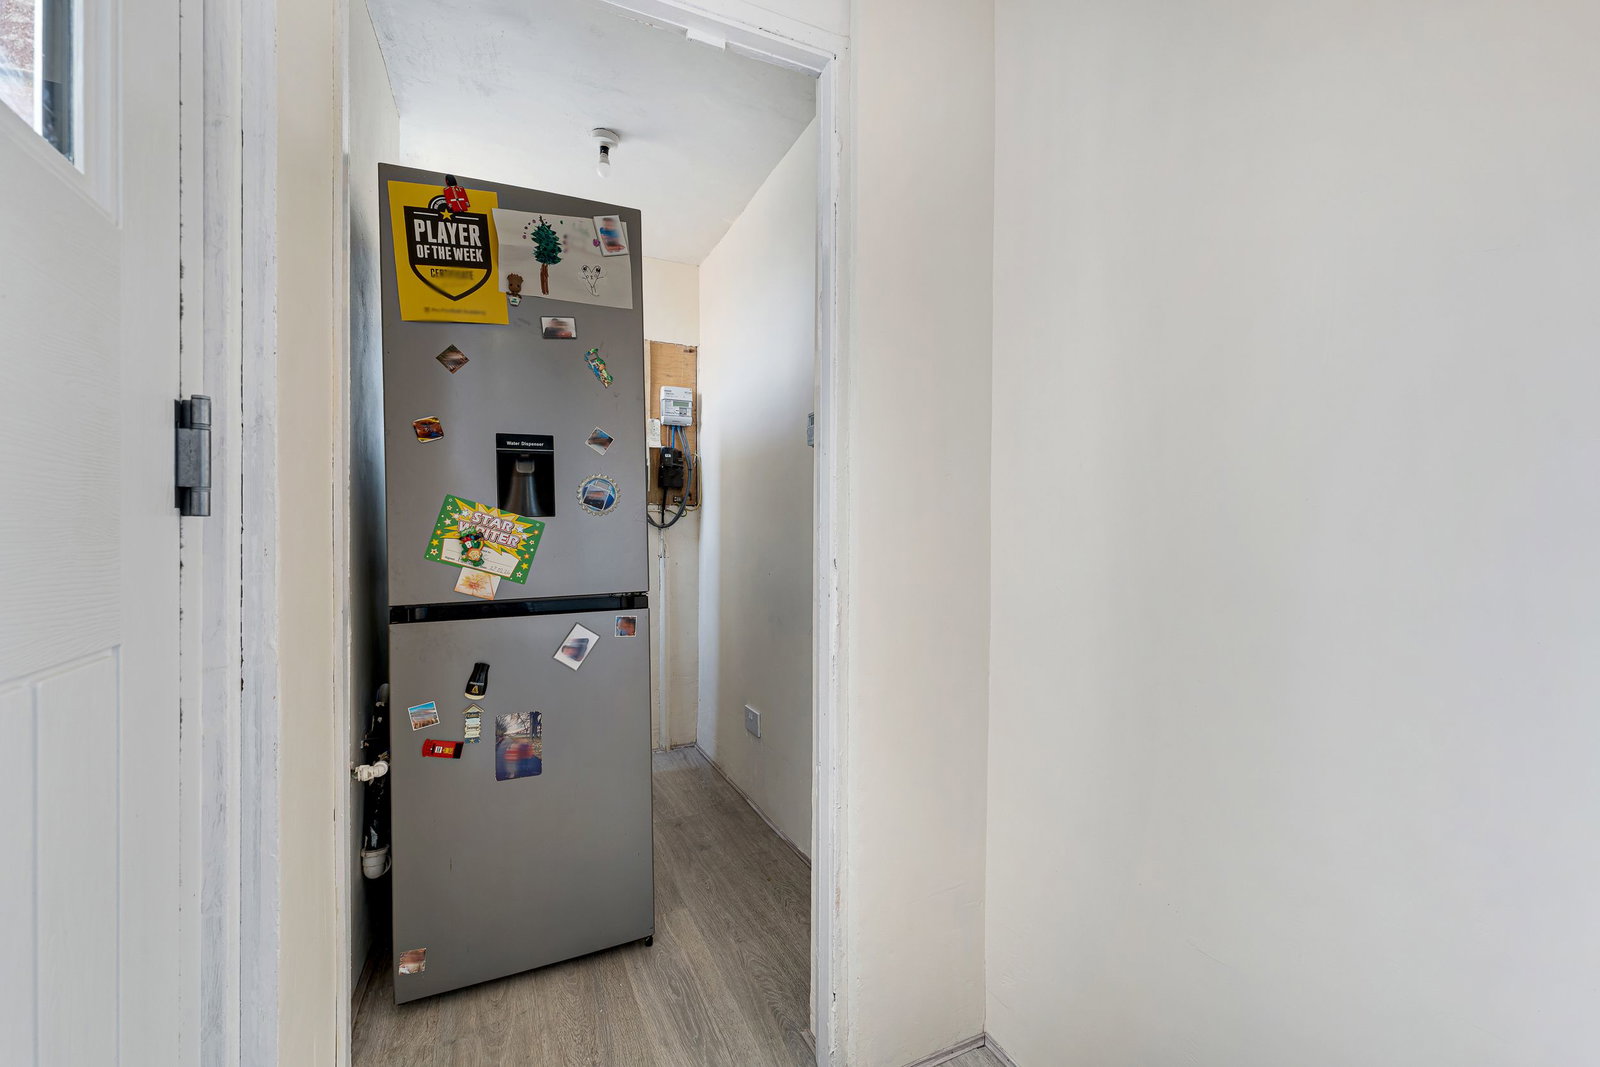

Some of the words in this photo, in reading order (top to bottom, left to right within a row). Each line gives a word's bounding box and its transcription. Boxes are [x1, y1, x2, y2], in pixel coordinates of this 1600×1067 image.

[413, 218, 482, 247] PLAYER
[416, 244, 431, 259] OF
[431, 245, 452, 260] THE
[453, 247, 484, 263] WEEK
[471, 511, 515, 534] STAR
